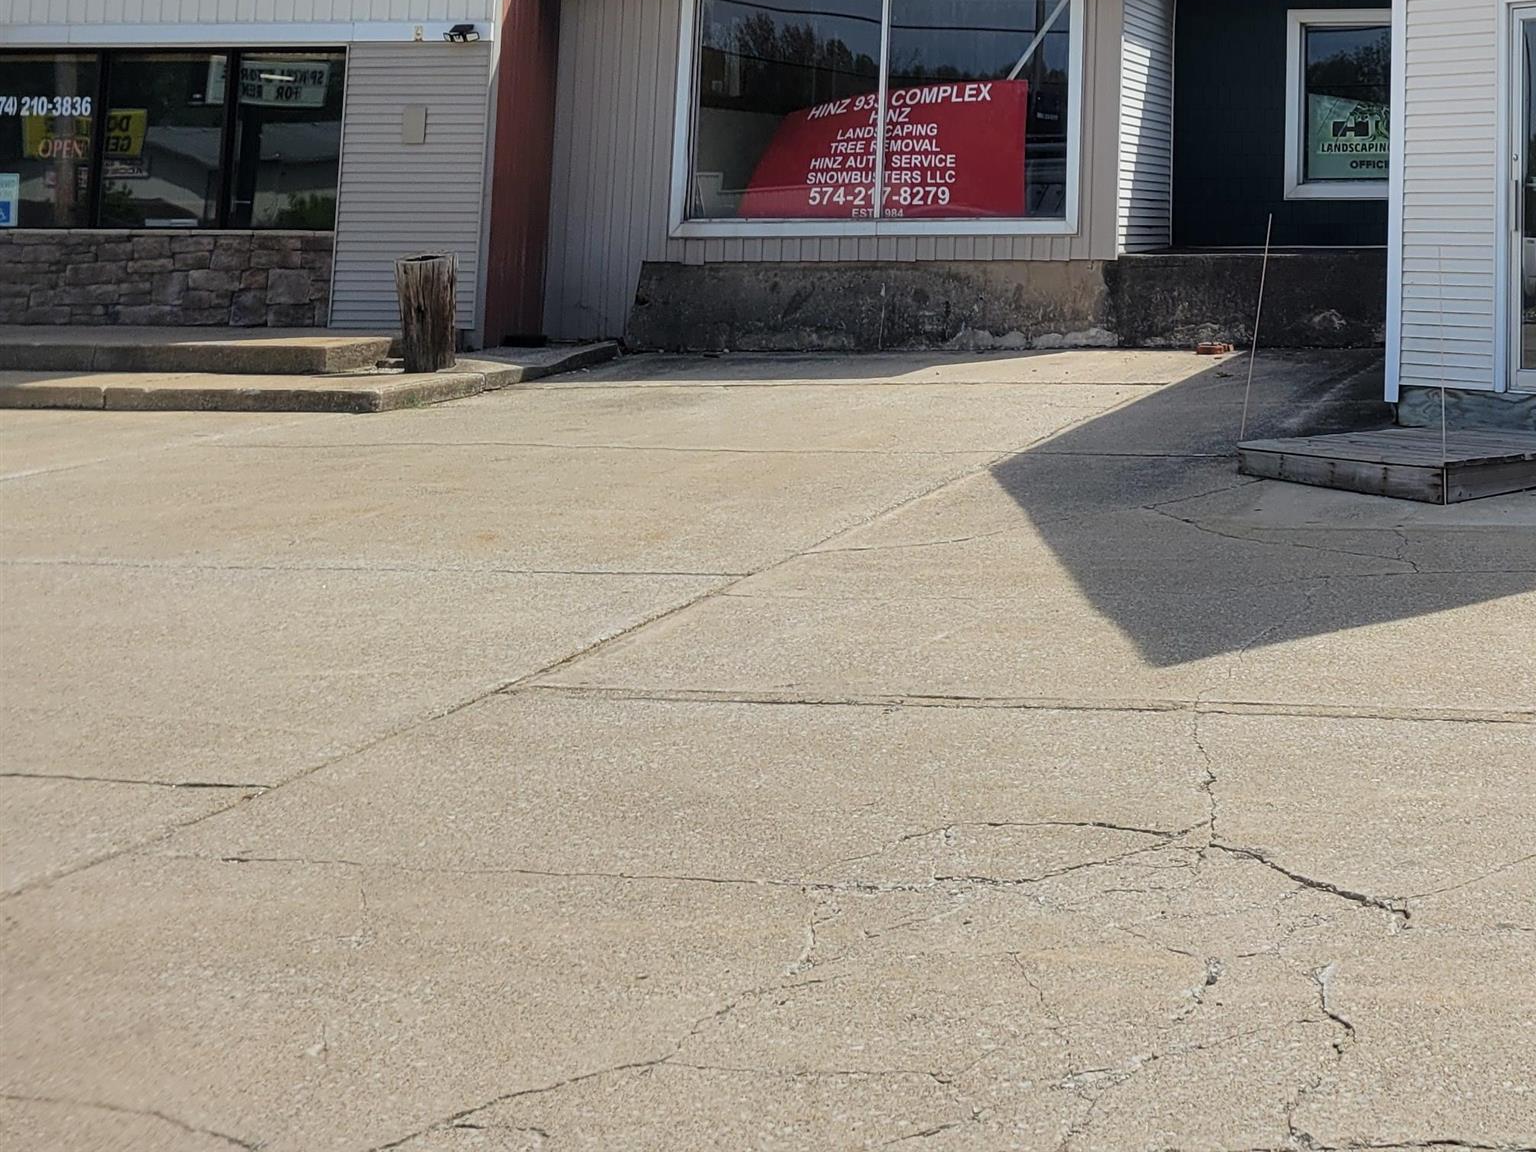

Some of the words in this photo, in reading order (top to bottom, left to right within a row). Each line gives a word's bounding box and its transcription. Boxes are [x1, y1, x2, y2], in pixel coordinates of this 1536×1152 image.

[20, 96, 92, 117] 210-3836
[807, 98, 851, 120] HINZ
[853, 94, 879, 111] 93
[891, 83, 992, 106] COMPLEX
[869, 107, 911, 125] HNZ
[39, 138, 83, 159] OPEN
[830, 141, 866, 154] TREE
[810, 156, 842, 169] HINZ
[845, 155, 885, 169] AUT
[891, 154, 956, 167] SERVICE
[927, 170, 956, 183] LLC
[808, 186, 950, 205] 574-217-8279
[884, 208, 904, 217] 984
